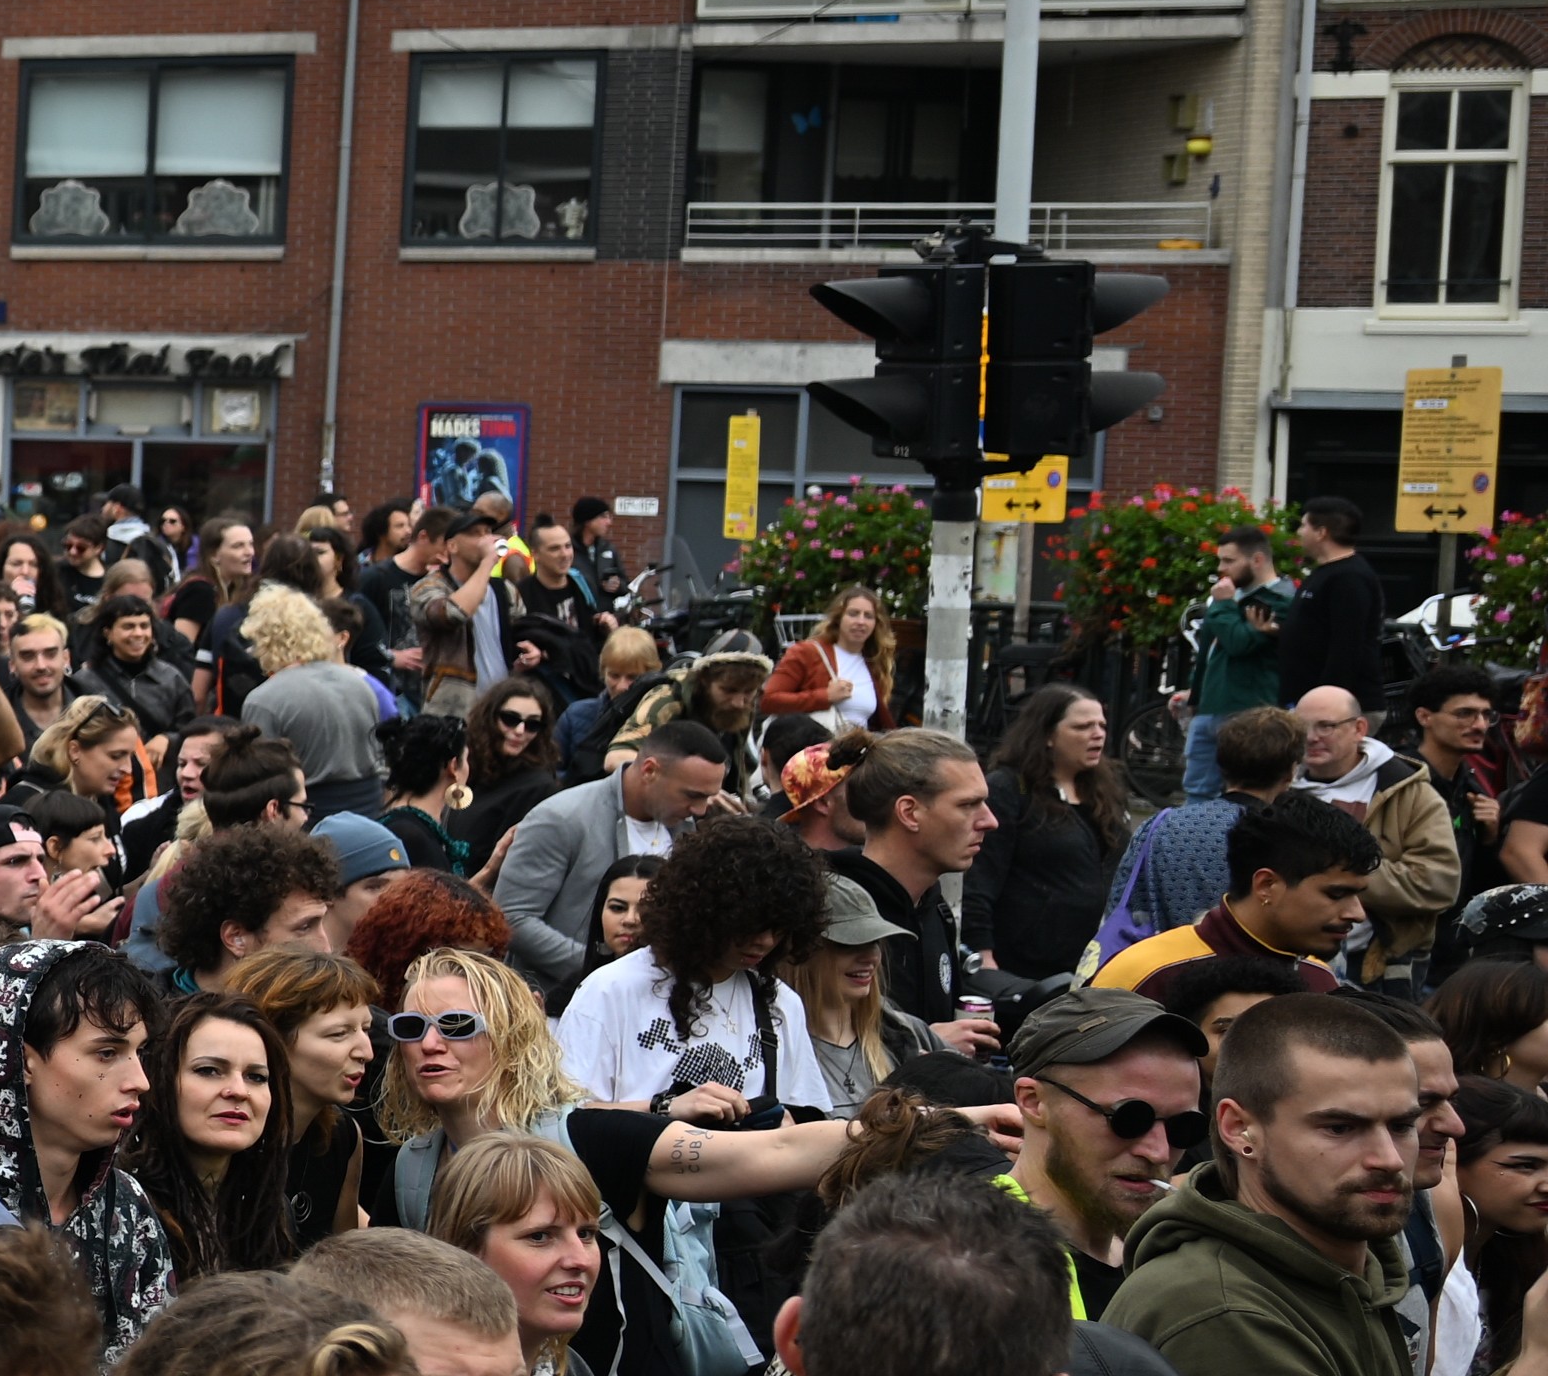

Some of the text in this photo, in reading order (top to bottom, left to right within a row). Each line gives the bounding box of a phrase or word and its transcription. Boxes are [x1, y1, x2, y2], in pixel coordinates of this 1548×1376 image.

[894, 444, 910, 458] 912
[671, 1138, 685, 1174] LION
[688, 1140, 702, 1173] CUB
